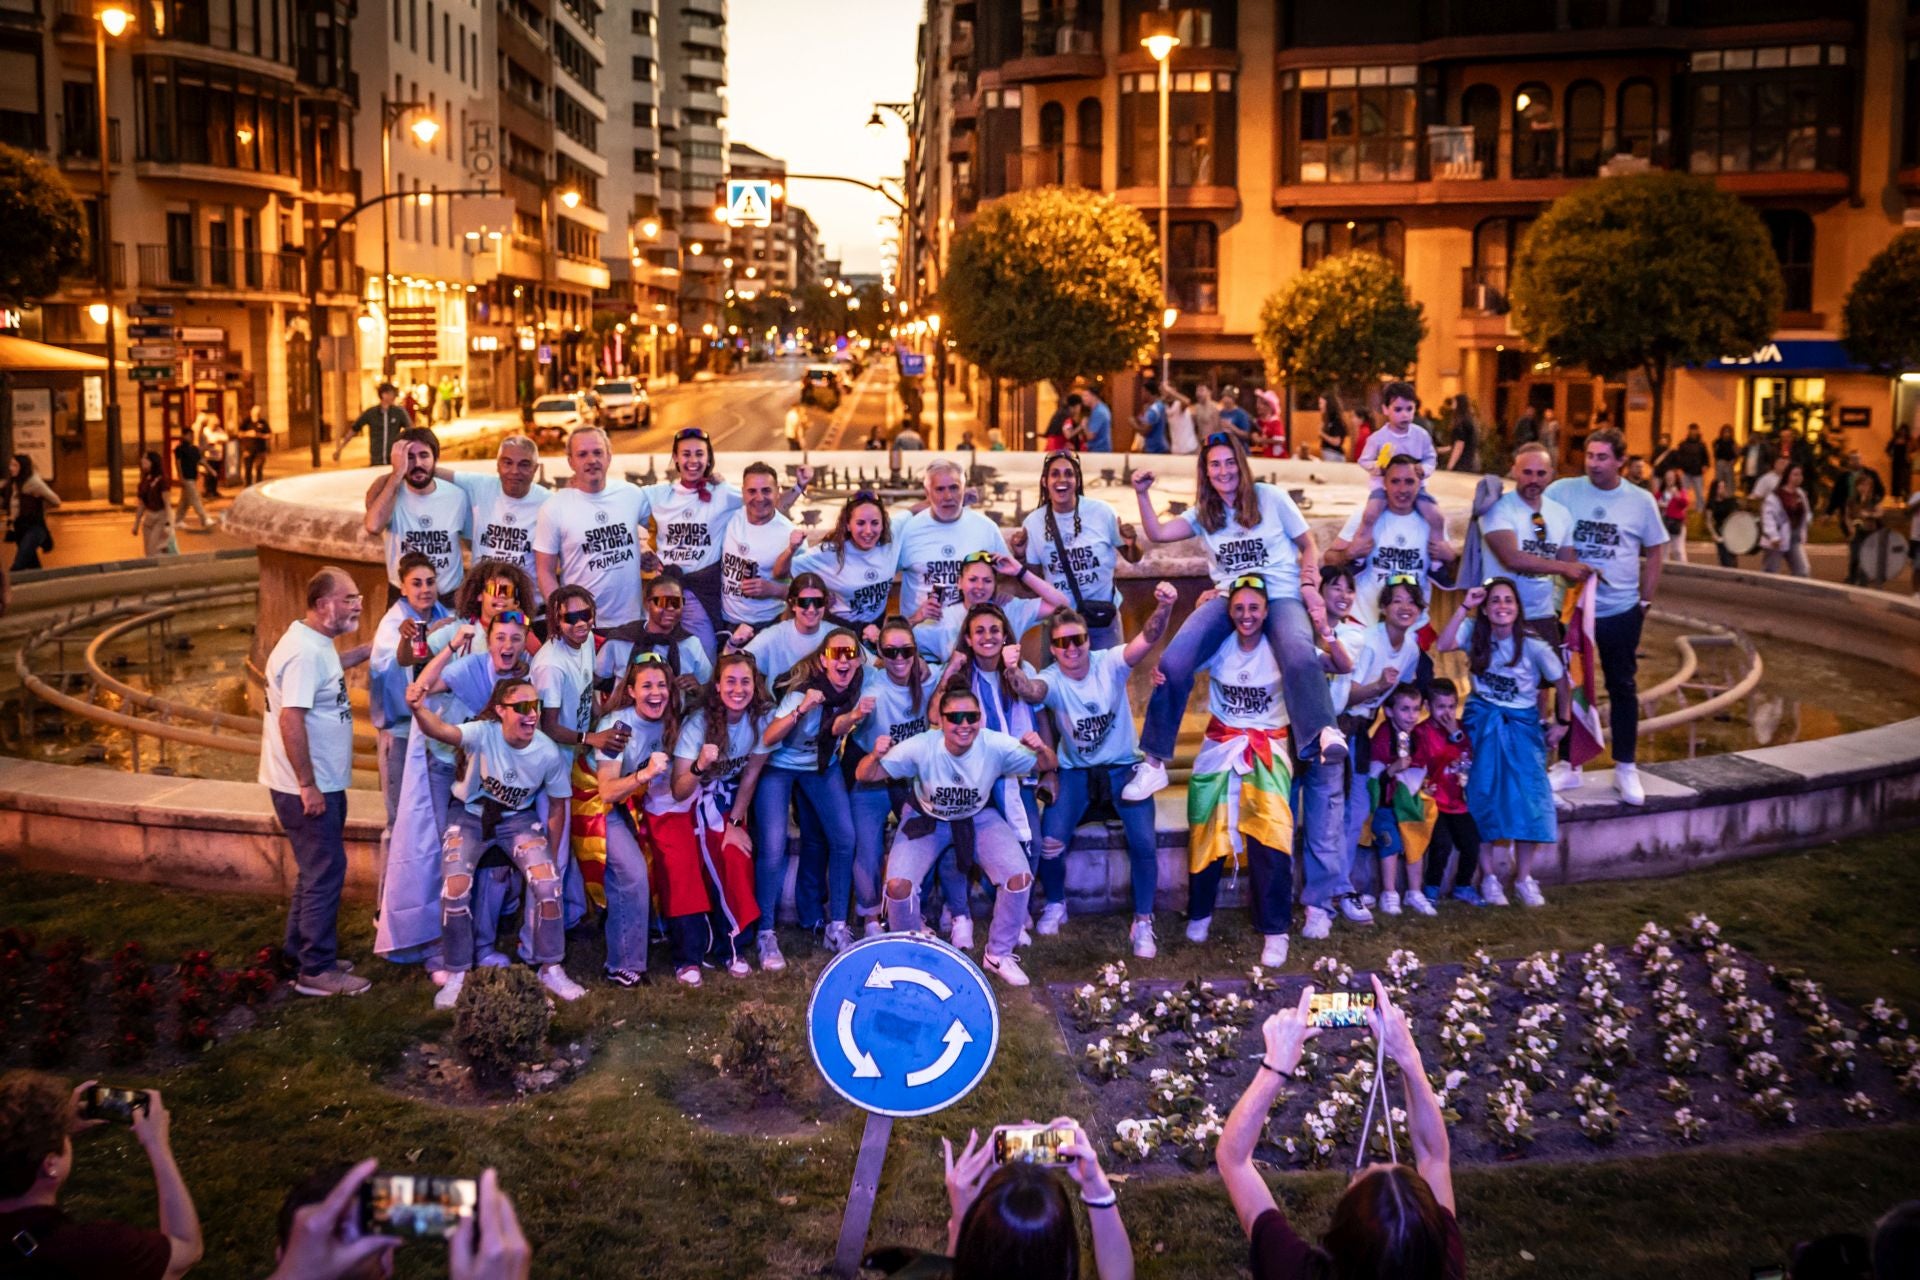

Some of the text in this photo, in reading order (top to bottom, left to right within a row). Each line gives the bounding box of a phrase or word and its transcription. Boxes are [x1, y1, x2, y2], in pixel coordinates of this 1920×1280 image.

[487, 524, 528, 541] SOMOS
[585, 523, 628, 542] SOMOS
[668, 523, 708, 535] SOMOS
[1577, 520, 1618, 534] SOMOS
[406, 530, 448, 542] SOMOS
[480, 533, 532, 553] HISTORIA
[582, 533, 634, 554] HISTORIA
[666, 533, 712, 546] HISTORIA
[1219, 538, 1264, 554] SOMOS
[1378, 547, 1420, 560] SOMOS
[588, 549, 634, 572] PRIMERA
[664, 549, 706, 562] PRIMERA
[1050, 546, 1092, 562] SMOS
[926, 560, 961, 574] SOMO
[1054, 572, 1100, 591] PRERA
[1222, 684, 1266, 698] SOMOS
[484, 776, 530, 798] SOMOS
[936, 787, 978, 799] SOMOS
